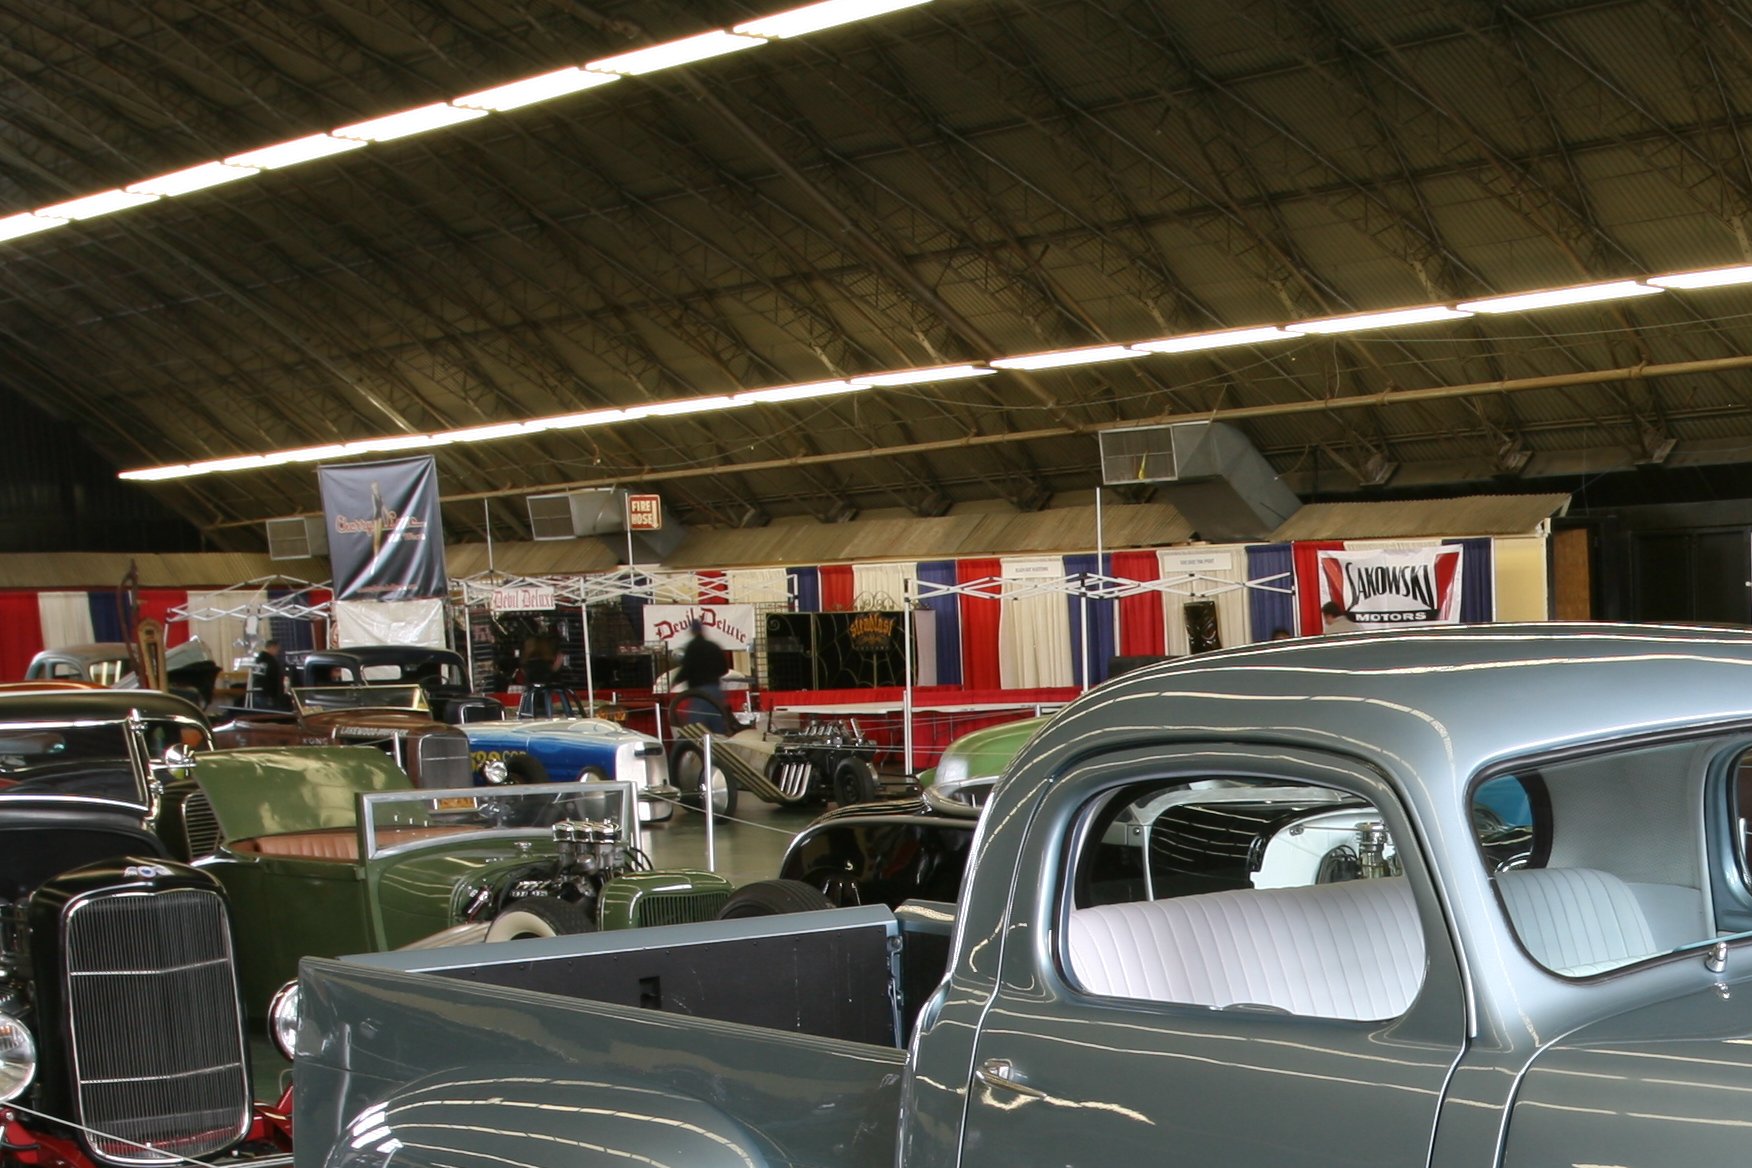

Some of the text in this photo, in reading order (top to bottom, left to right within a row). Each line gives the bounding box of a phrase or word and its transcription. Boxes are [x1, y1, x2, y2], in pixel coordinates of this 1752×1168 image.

[1345, 562, 1434, 611] SAKOWSKI
[700, 607, 746, 643] Deluxe
[1355, 611, 1427, 621] MOTORS
